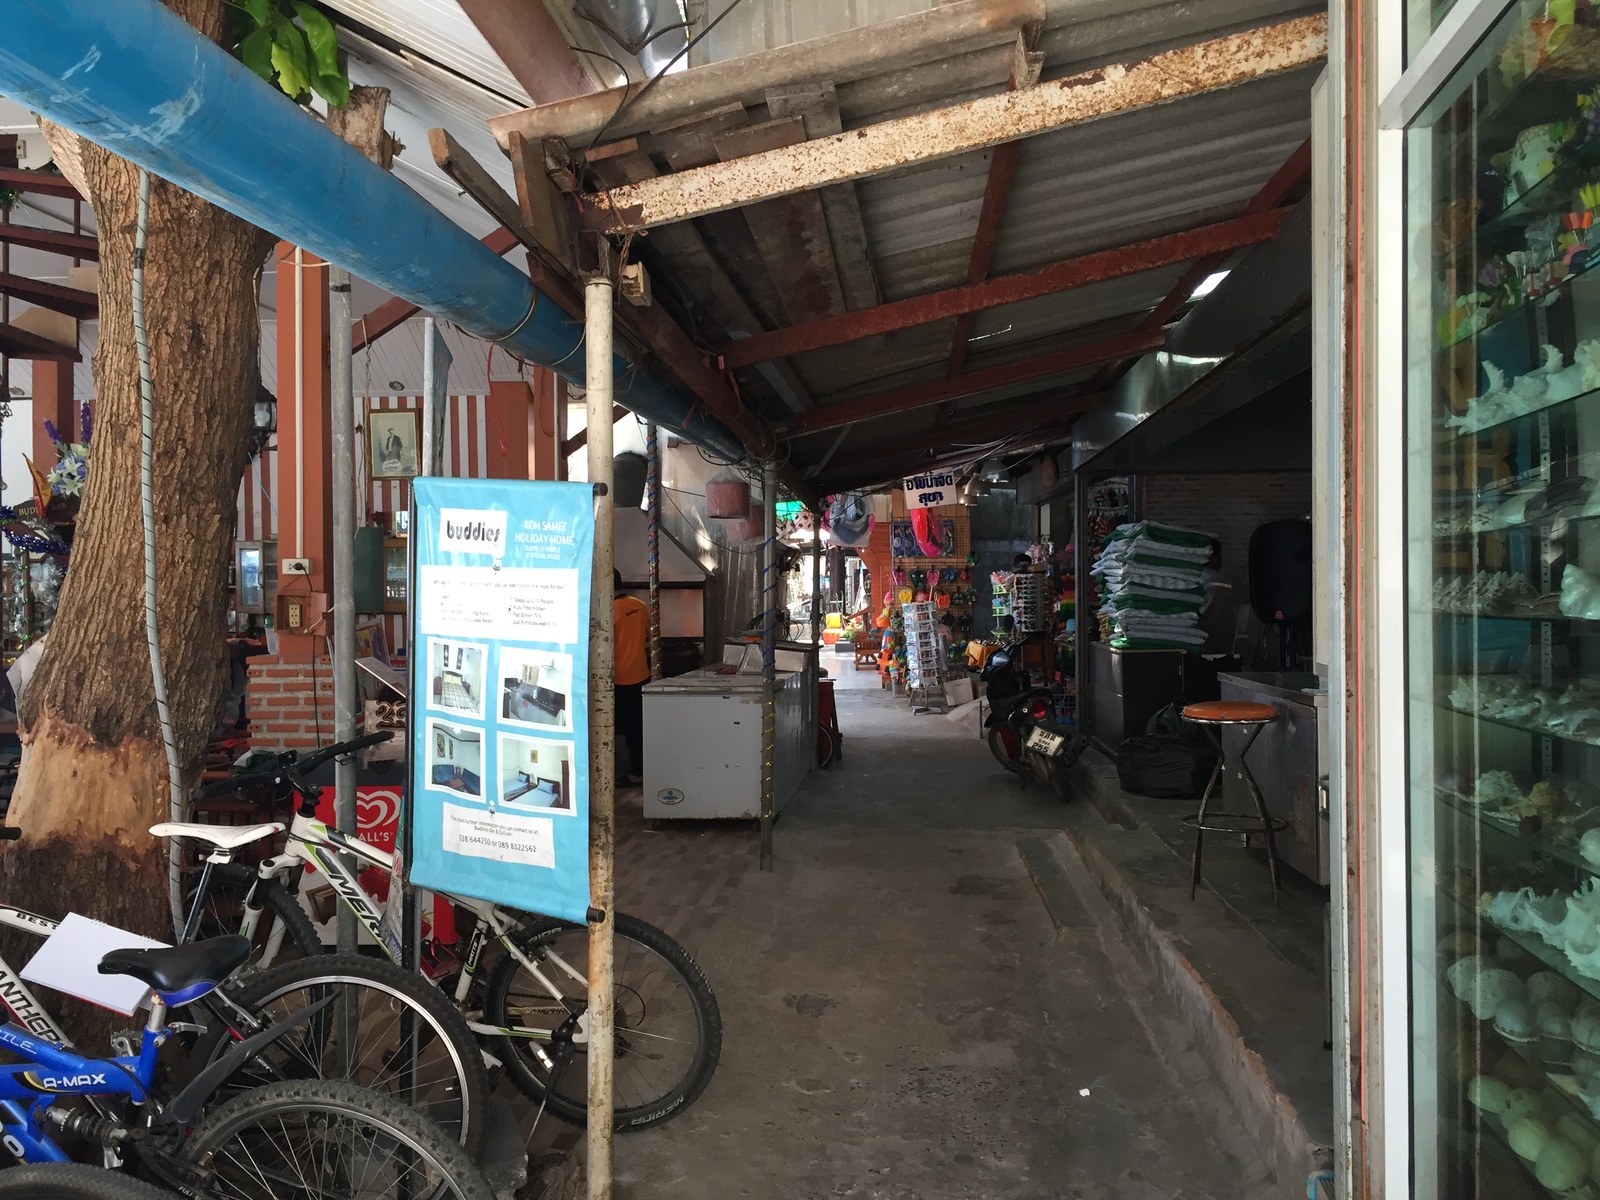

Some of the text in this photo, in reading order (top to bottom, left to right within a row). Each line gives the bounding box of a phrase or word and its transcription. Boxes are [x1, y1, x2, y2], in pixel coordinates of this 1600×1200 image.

[446, 520, 501, 543] buddies
[524, 519, 568, 532] KOH SAMET
[515, 532, 574, 546] HOLIDAY HOME
[1031, 742, 1049, 753] 255
[358, 831, 390, 842] ALL'S
[459, 834, 469, 843] 038
[498, 840, 509, 849] 089
[510, 842, 537, 853] 8322562
[43, 1073, 107, 1089] A-MAX
[631, 1094, 685, 1126] MERIDA
